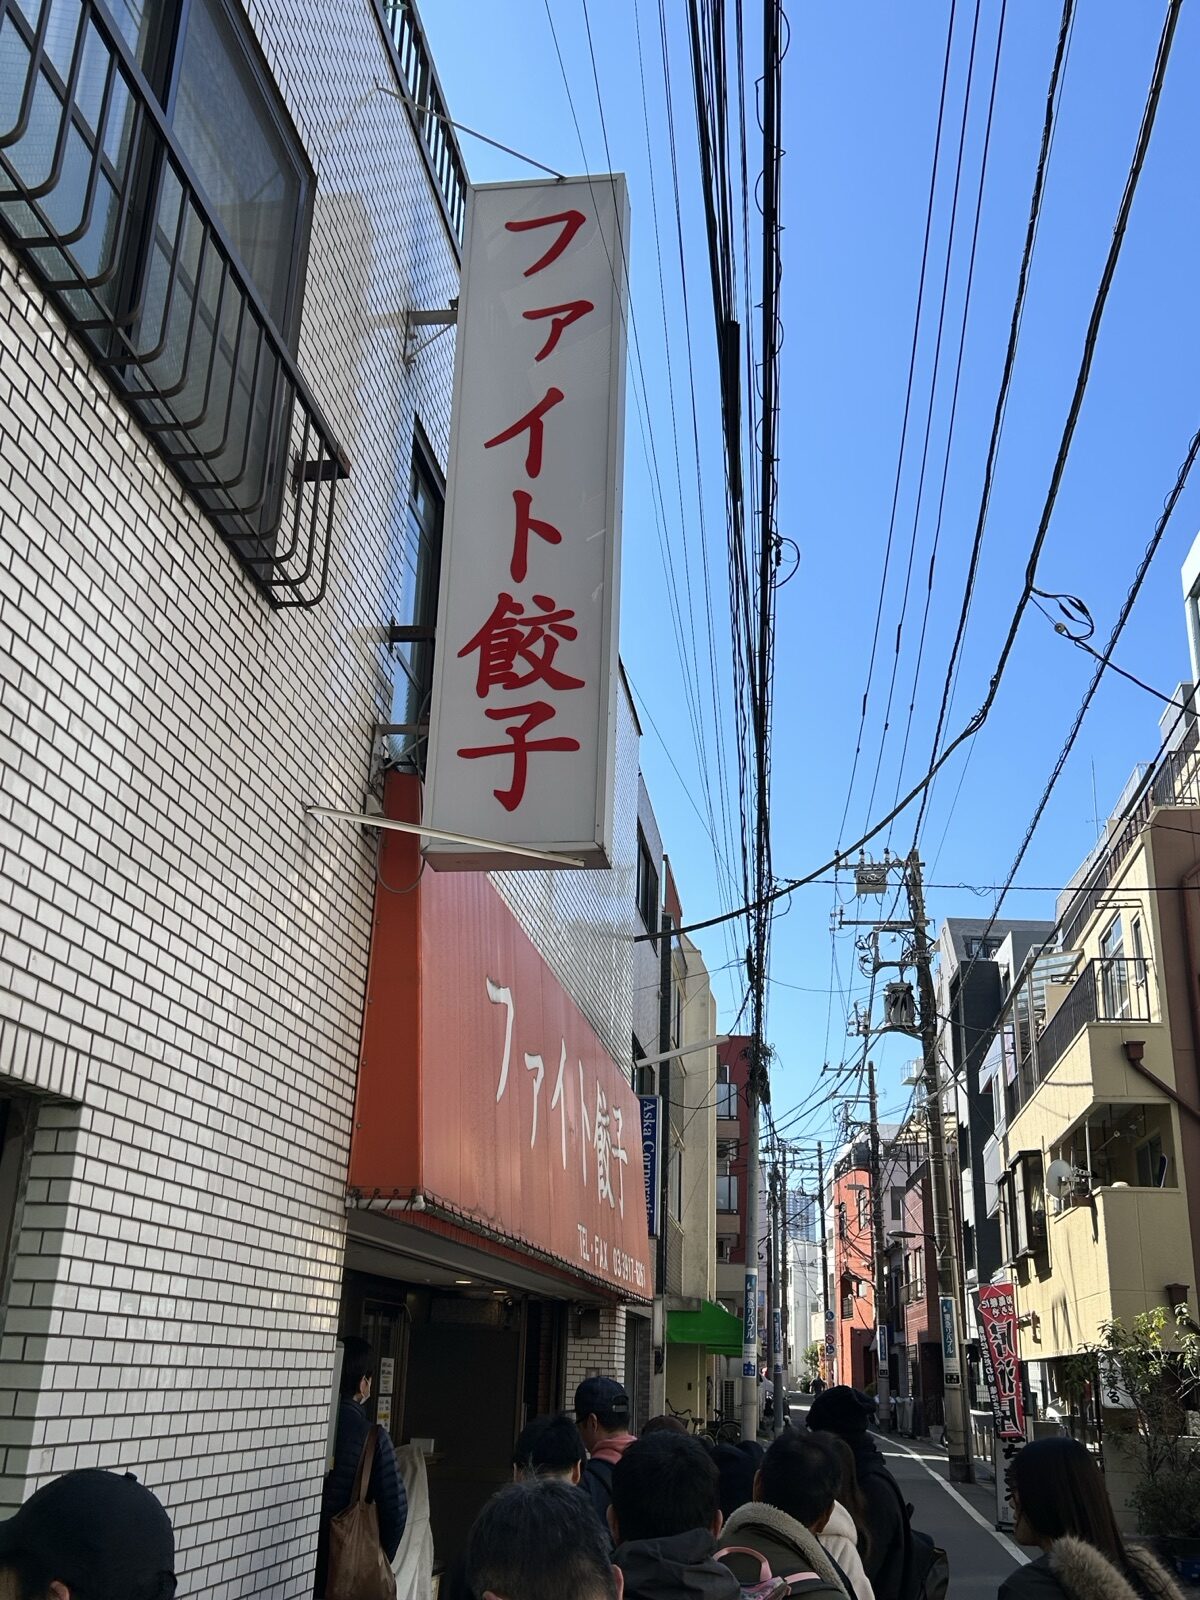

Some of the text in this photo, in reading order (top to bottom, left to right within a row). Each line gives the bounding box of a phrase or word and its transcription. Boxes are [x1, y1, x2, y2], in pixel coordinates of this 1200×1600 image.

[457, 209, 595, 812] ファイト餃子
[486, 974, 628, 1220] ファイト餃子
[643, 1100, 656, 1136] Aska
